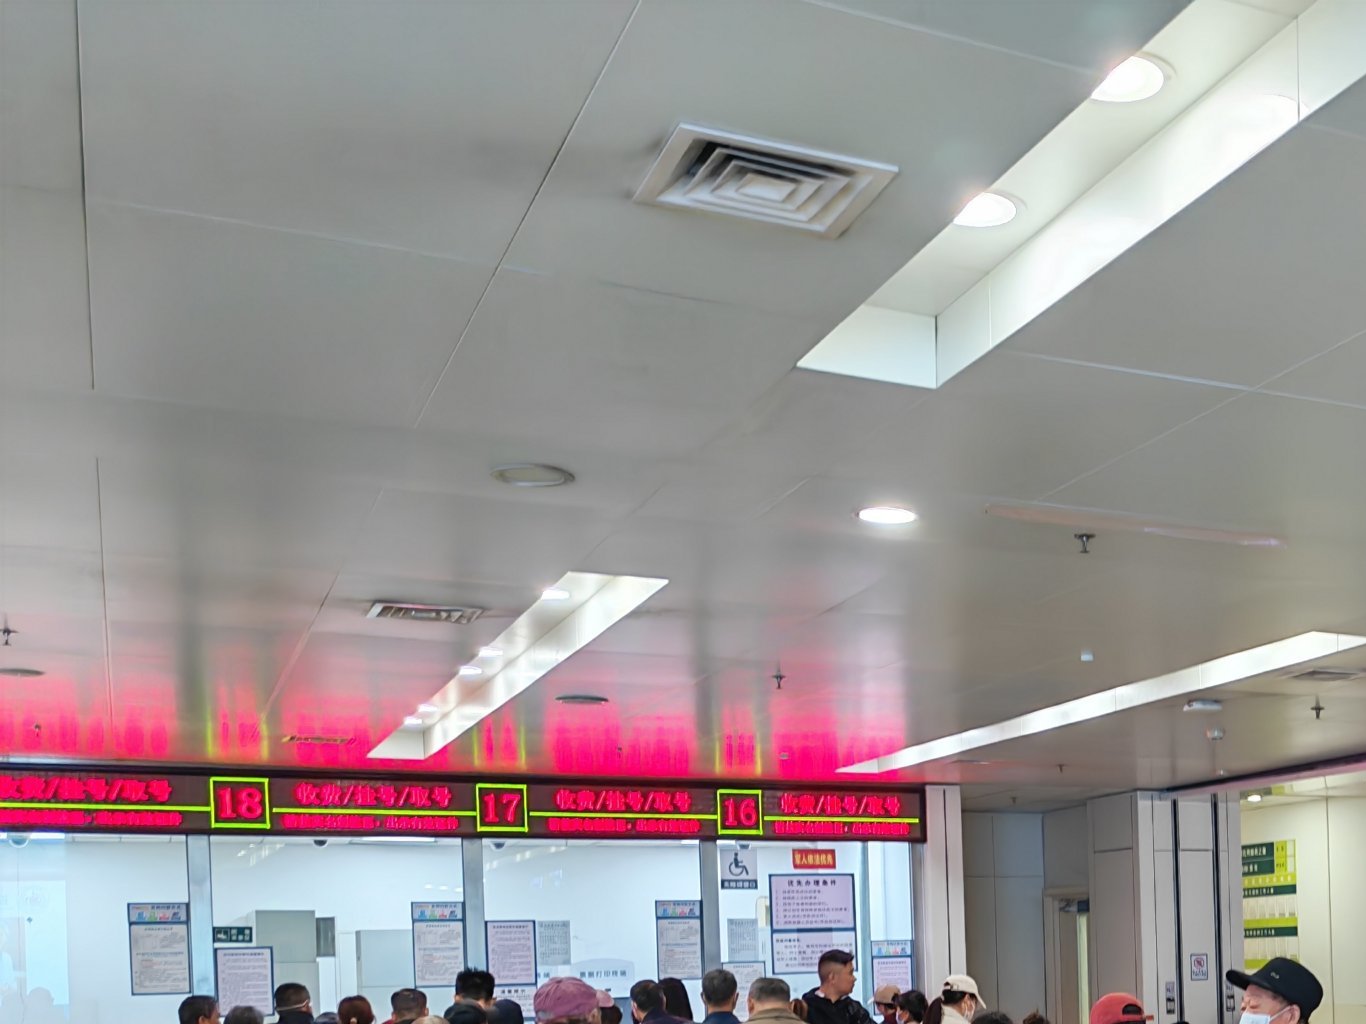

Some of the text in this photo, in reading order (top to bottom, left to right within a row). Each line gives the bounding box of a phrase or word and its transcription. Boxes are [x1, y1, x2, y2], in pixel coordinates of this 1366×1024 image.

[216, 787, 263, 819] 18
[484, 793, 521, 823] 17
[723, 797, 757, 827] 16
